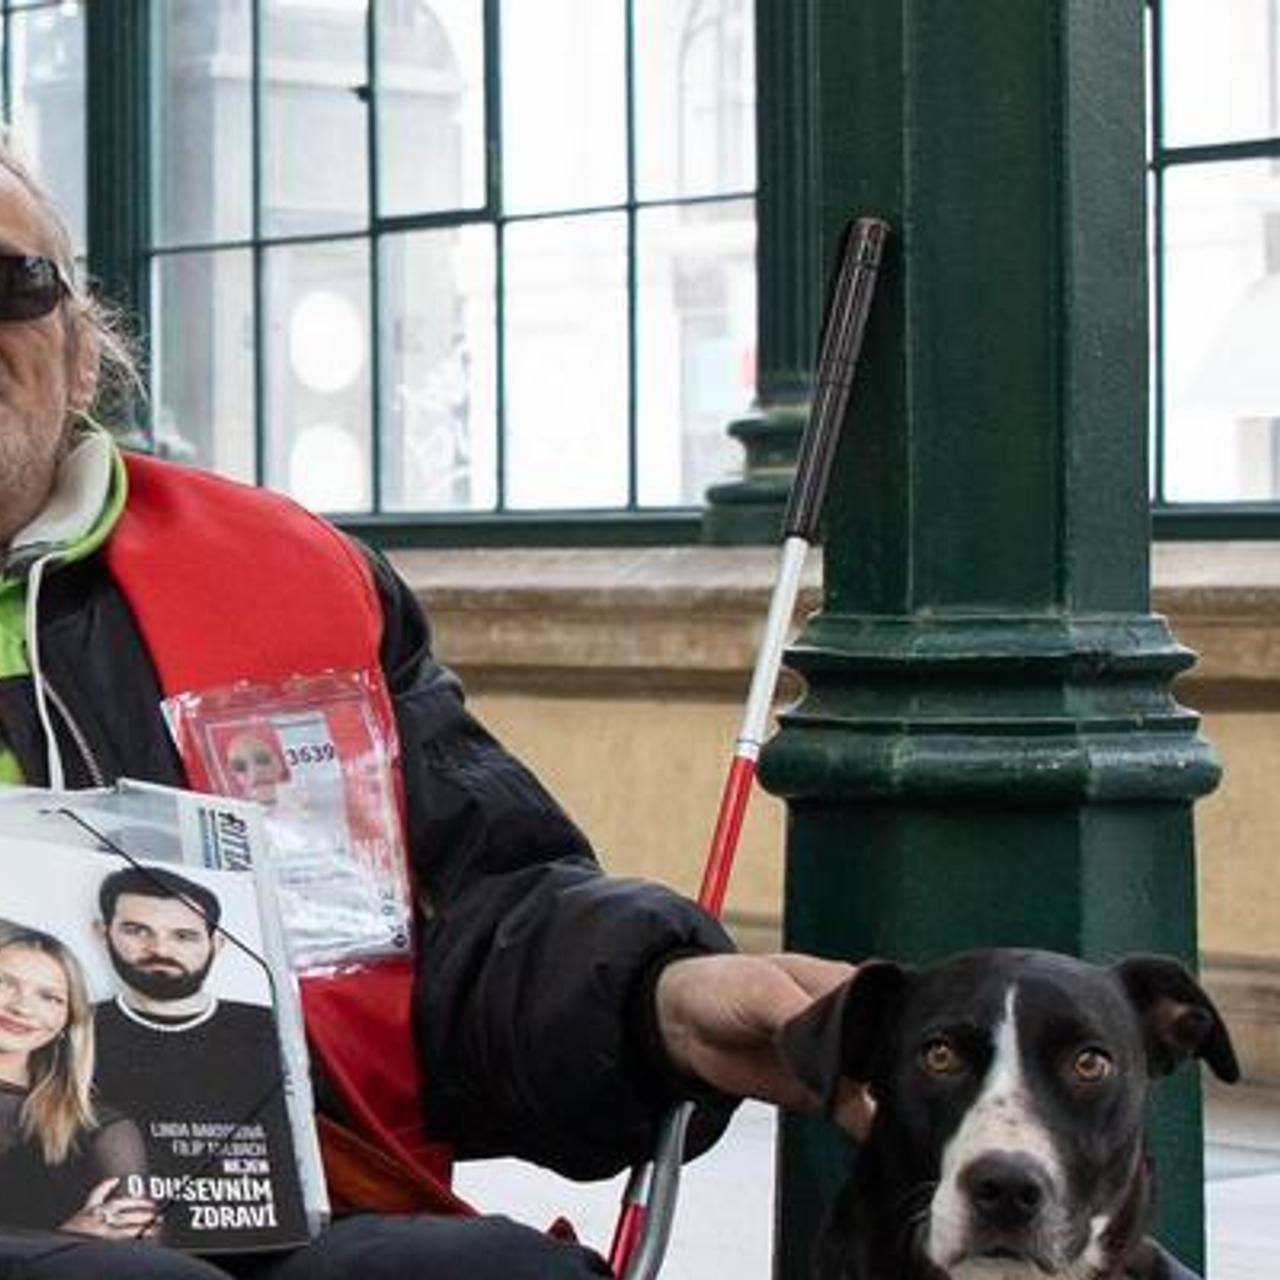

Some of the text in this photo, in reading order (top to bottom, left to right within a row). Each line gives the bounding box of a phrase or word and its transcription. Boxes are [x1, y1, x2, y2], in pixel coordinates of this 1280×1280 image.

[286, 742, 335, 767] 3639
[127, 1173, 273, 1202] O DUŠEVNÍM
[188, 1201, 277, 1229] ZDRAVÍ
